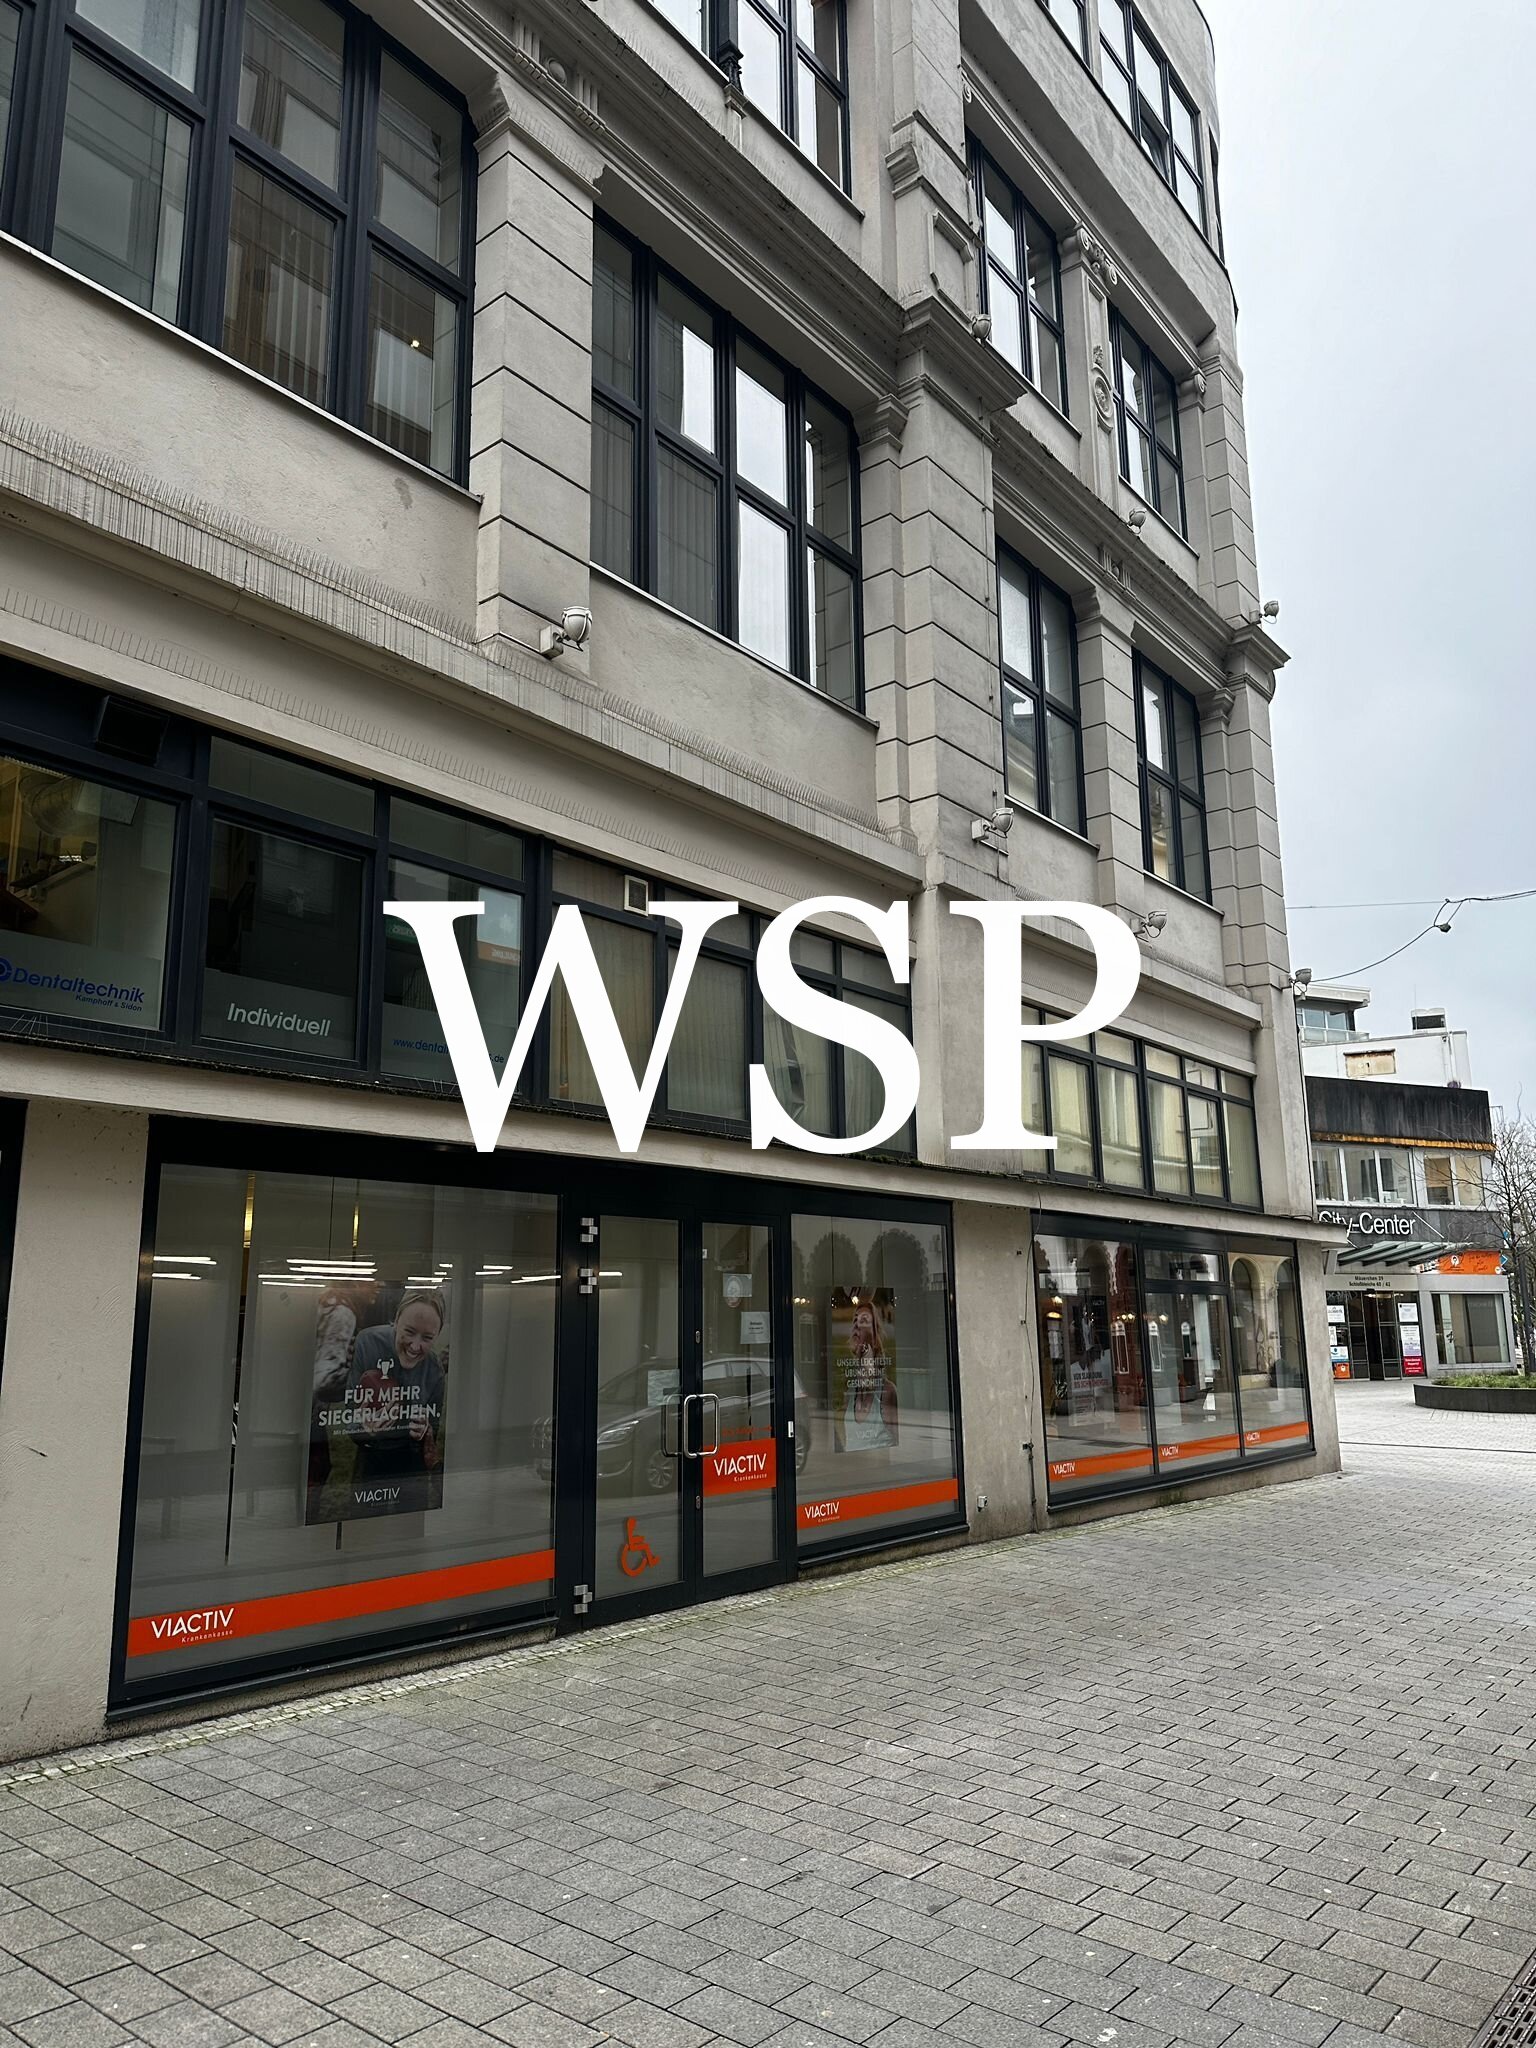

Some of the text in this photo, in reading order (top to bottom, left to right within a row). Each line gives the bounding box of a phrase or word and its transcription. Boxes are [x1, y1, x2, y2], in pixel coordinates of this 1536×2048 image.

[13, 967, 145, 1003] Dentaltechnik
[76, 994, 113, 1008] Kamphoff
[120, 1001, 143, 1012] Sidon
[227, 1003, 331, 1036] Individuell
[344, 1385, 420, 1404] FÜR MEHR
[318, 1403, 441, 1426] SIEGERLÄCHELN.
[714, 1453, 767, 1476] VIACTIV
[1053, 1461, 1075, 1475] VIACTIV
[354, 1487, 400, 1503] VIACTIV
[804, 1501, 840, 1519] VIACTIV
[151, 1608, 235, 1639] VIACTIV
[181, 1629, 234, 1643] Krankenkasse
